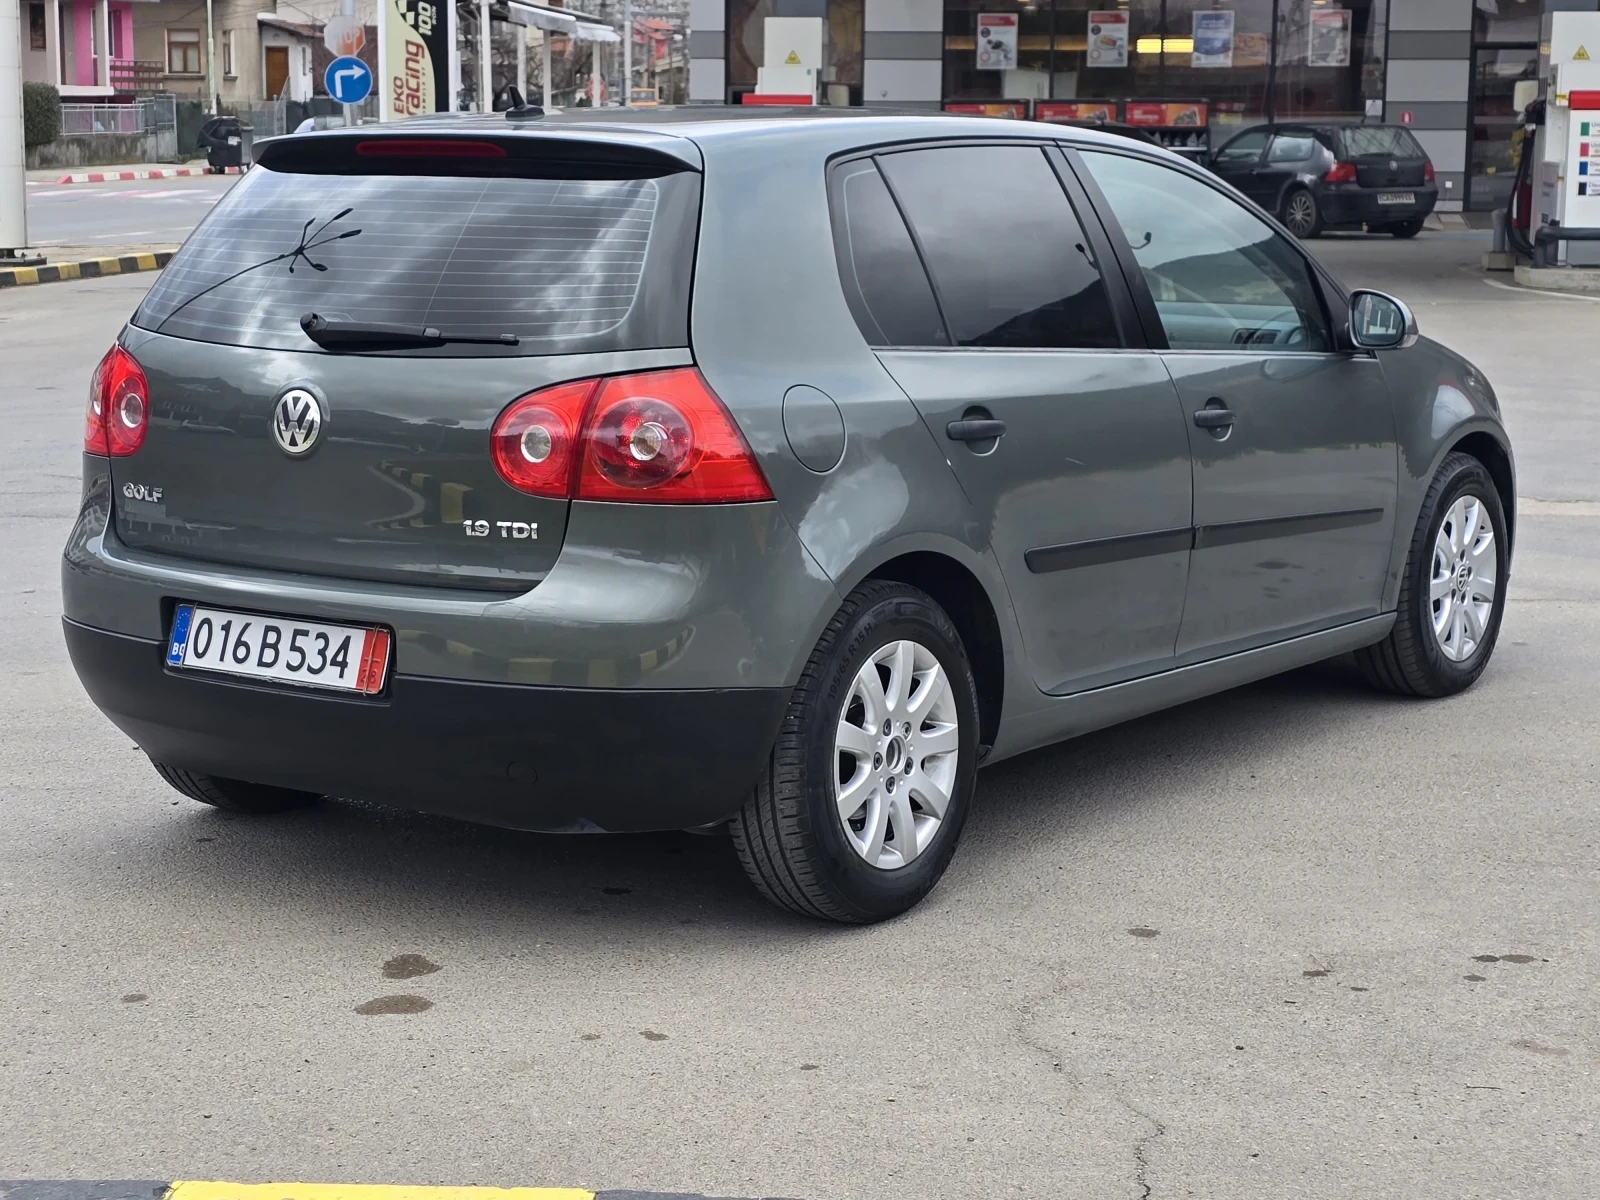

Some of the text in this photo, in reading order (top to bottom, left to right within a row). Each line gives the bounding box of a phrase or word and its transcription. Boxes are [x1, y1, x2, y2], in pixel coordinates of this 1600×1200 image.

[417, 1, 432, 35] 100
[393, 76, 405, 114] EKO
[405, 39, 425, 116] racing
[122, 482, 163, 502] GOLF
[193, 617, 352, 679] 016B534
[827, 656, 850, 700] 195/65
